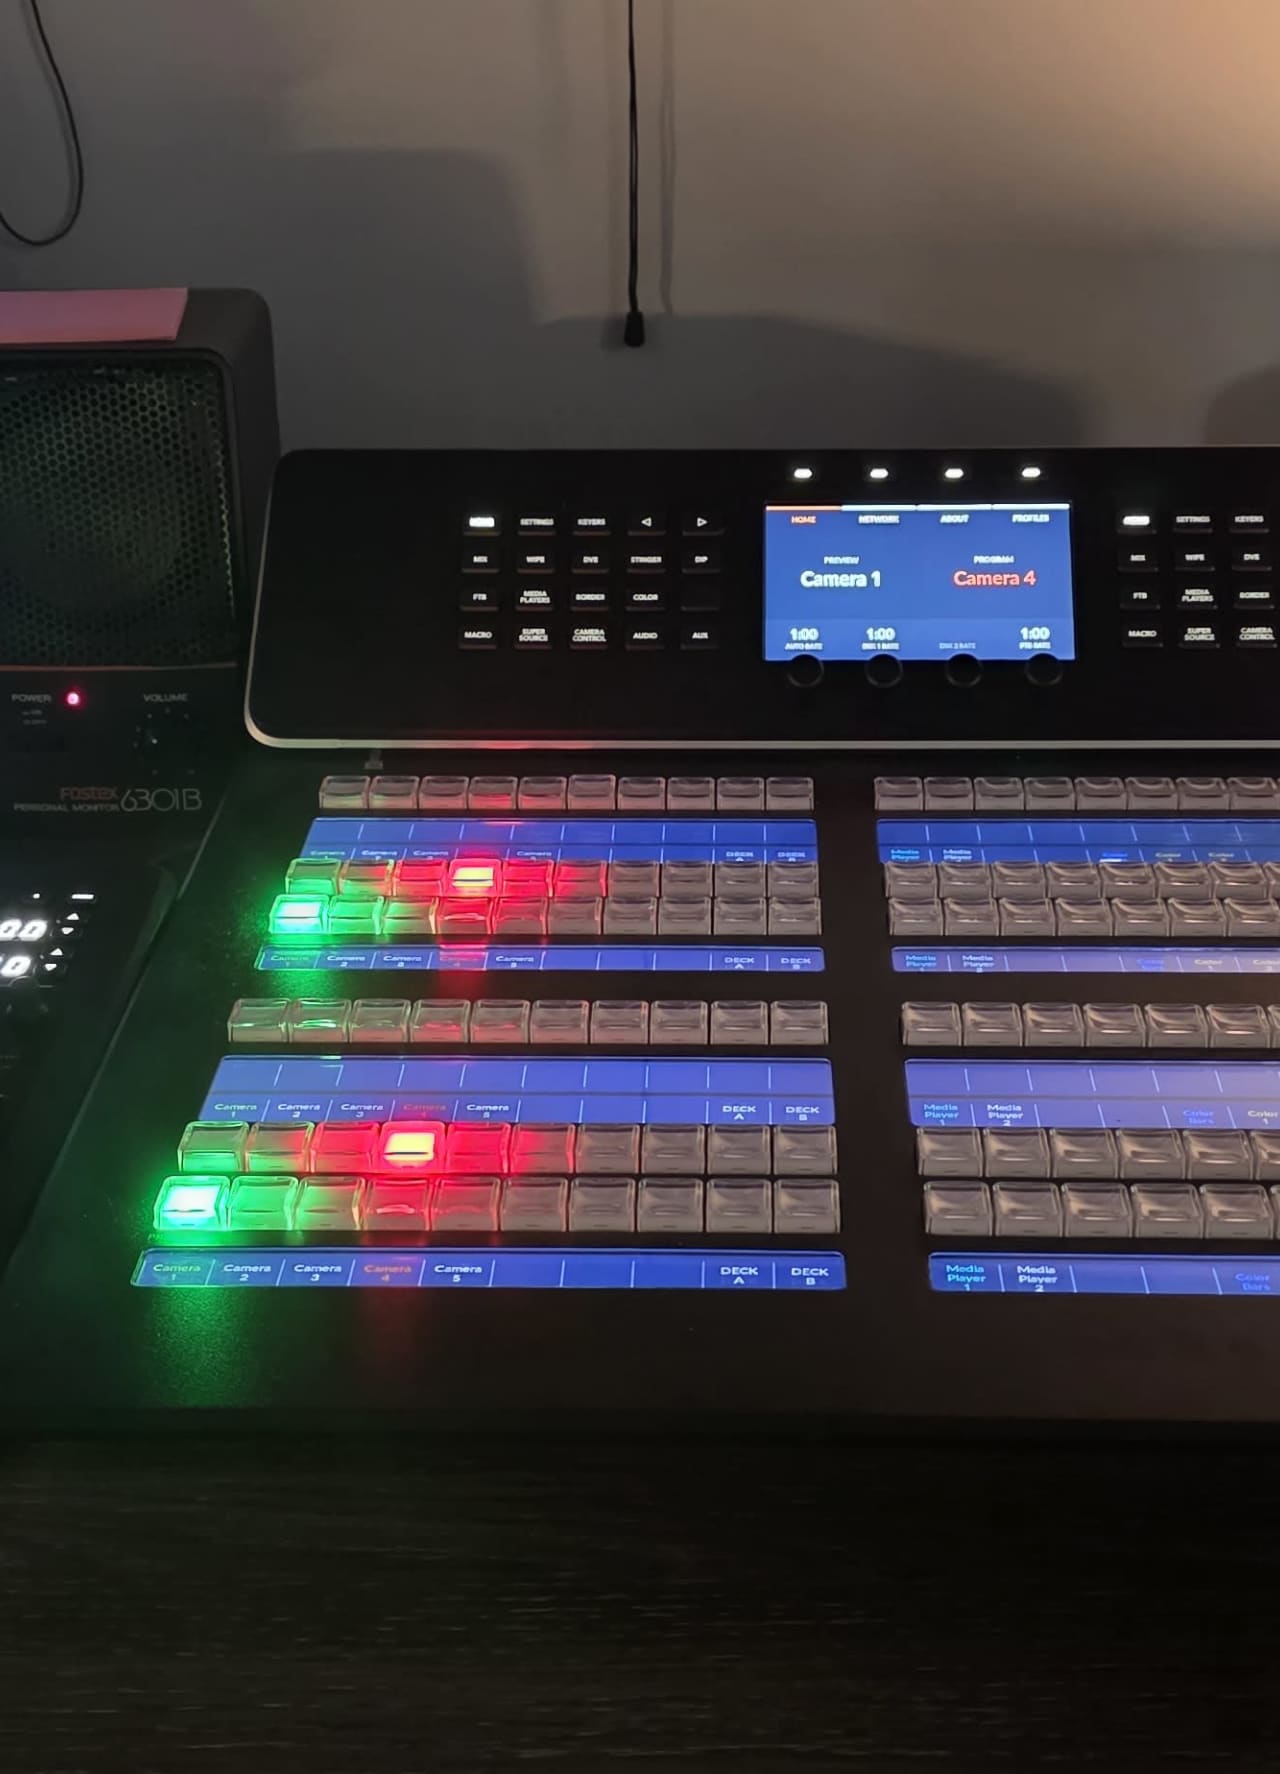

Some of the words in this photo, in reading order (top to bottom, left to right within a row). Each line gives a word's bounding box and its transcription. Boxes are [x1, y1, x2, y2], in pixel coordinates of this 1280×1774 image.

[800, 571, 868, 588] Camera
[871, 571, 881, 587] 1
[953, 571, 1019, 587] Camera
[1023, 570, 1037, 586] 4
[790, 628, 819, 641] 1:00
[866, 628, 896, 641] 1:00
[1020, 627, 1050, 640] 1:00
[120, 788, 202, 812] 6301B
[340, 1104, 384, 1112] Camera
[466, 1104, 510, 1112] Camera
[786, 1106, 820, 1114] DECK
[987, 1104, 1022, 1112] Media
[988, 1112, 1024, 1120] Player
[224, 1264, 272, 1273] Camera
[294, 1264, 342, 1273] Camera
[434, 1264, 482, 1274] Camera
[720, 1266, 759, 1276] DECK
[792, 1268, 829, 1277] DECK
[946, 1265, 984, 1274] Media
[1017, 1266, 1056, 1275] Media
[310, 1274, 320, 1282] 3
[452, 1274, 461, 1282] 5
[734, 1276, 745, 1285] A
[806, 1277, 816, 1286] B
[947, 1274, 986, 1284] Player
[1018, 1275, 1058, 1284] Player
[964, 1284, 971, 1292] 1
[1034, 1285, 1044, 1293] 2
